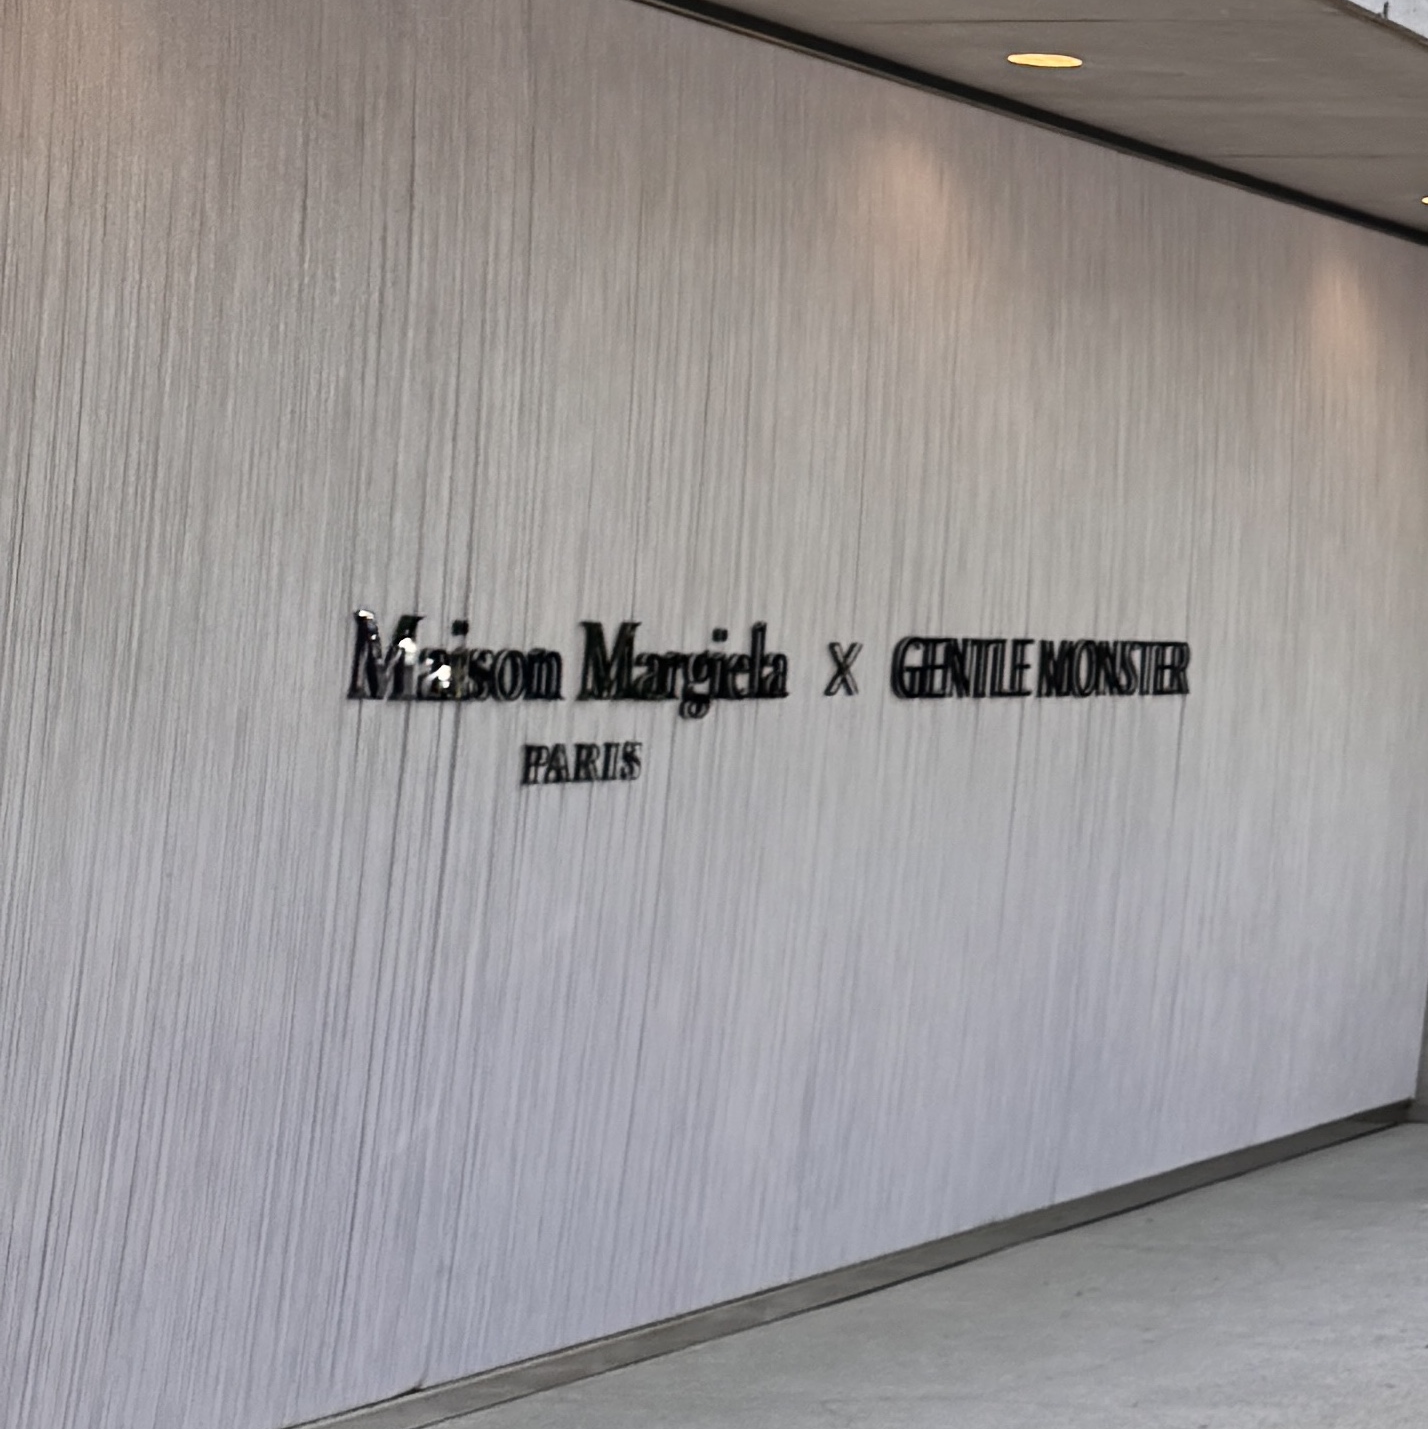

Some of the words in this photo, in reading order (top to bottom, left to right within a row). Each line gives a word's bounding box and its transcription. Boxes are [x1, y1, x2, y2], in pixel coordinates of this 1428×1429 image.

[347, 609, 565, 701] Maison
[575, 620, 789, 719] Margiela
[891, 636, 1034, 698] GENTLE
[1036, 639, 1190, 698] MONSTER
[521, 740, 643, 784] PARIS
